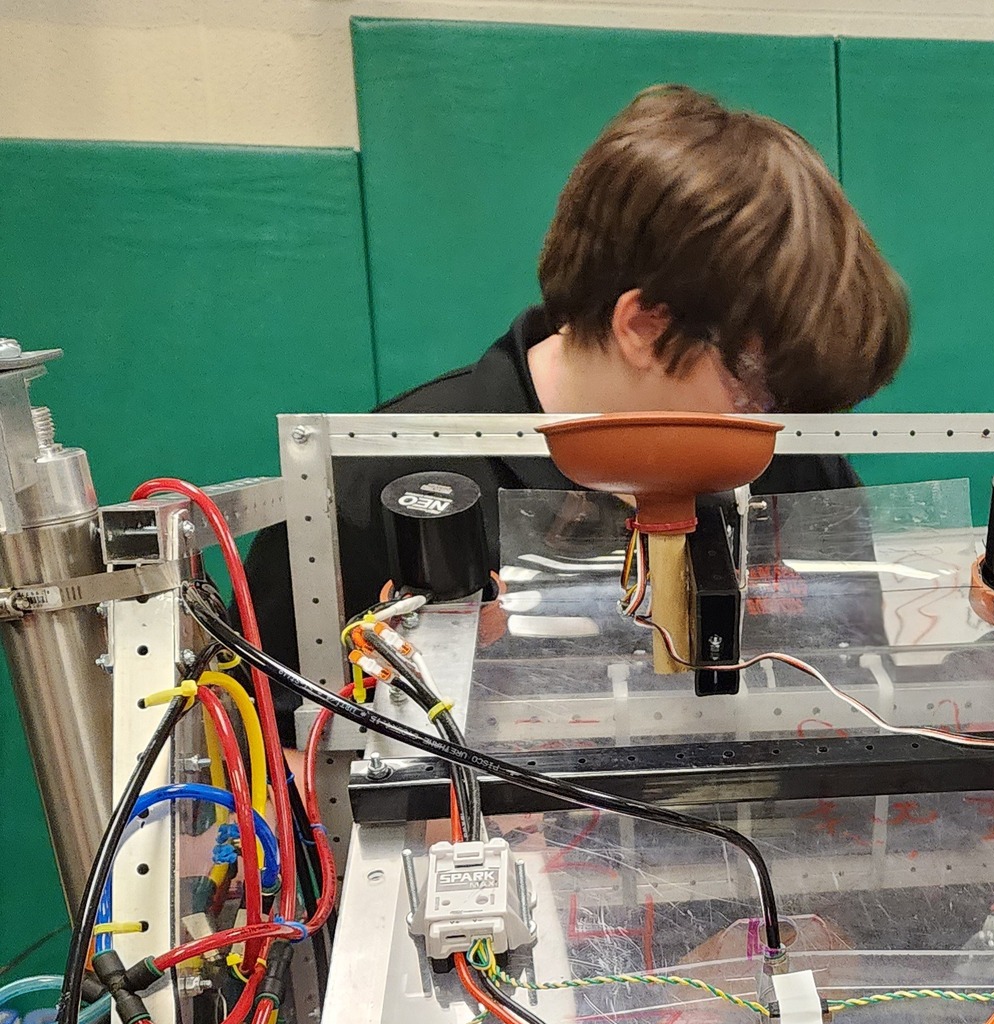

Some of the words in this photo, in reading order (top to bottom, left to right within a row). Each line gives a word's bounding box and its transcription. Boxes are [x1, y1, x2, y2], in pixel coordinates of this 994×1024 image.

[398, 494, 451, 513] NEO
[423, 736, 468, 760] URETHANE
[471, 755, 500, 772] PISCO
[440, 871, 495, 884] SPARK
[470, 881, 495, 889] MAX
